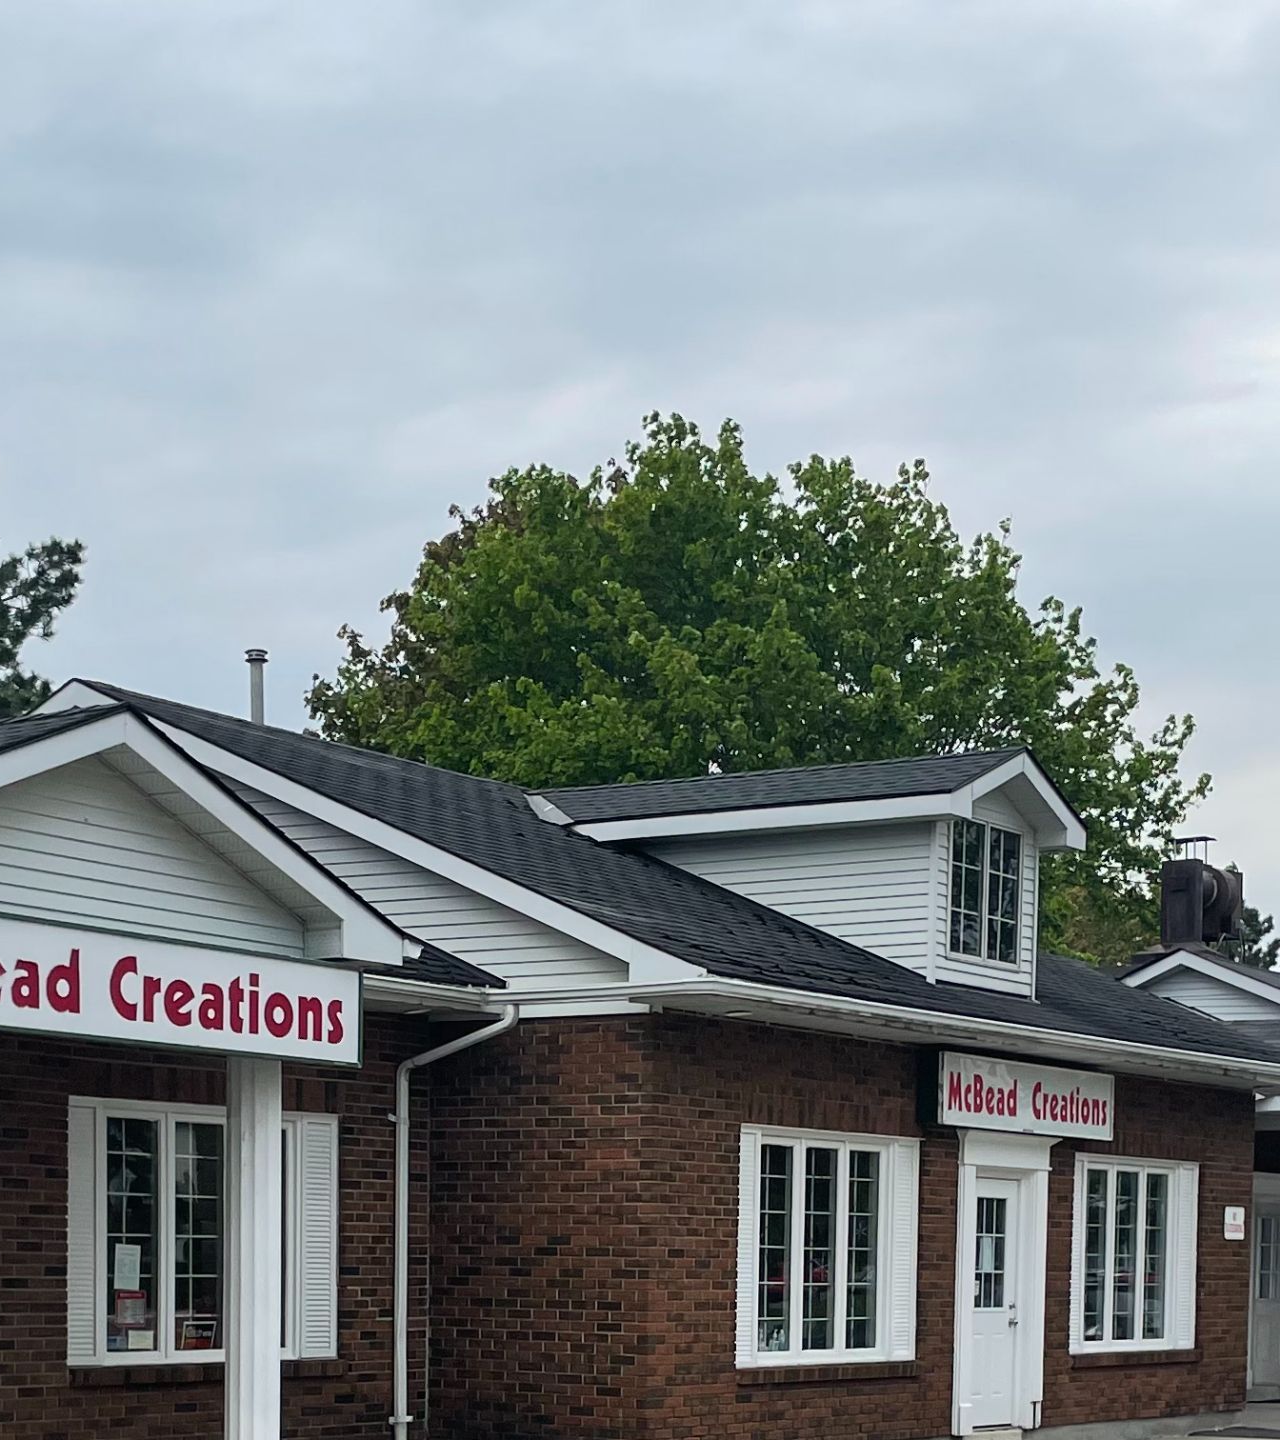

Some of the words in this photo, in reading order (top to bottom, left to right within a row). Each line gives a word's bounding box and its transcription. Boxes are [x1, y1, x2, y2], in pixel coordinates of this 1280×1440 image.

[110, 956, 343, 1044] Creations
[948, 1071, 1018, 1116] McBead
[1032, 1081, 1107, 1126] Creations
